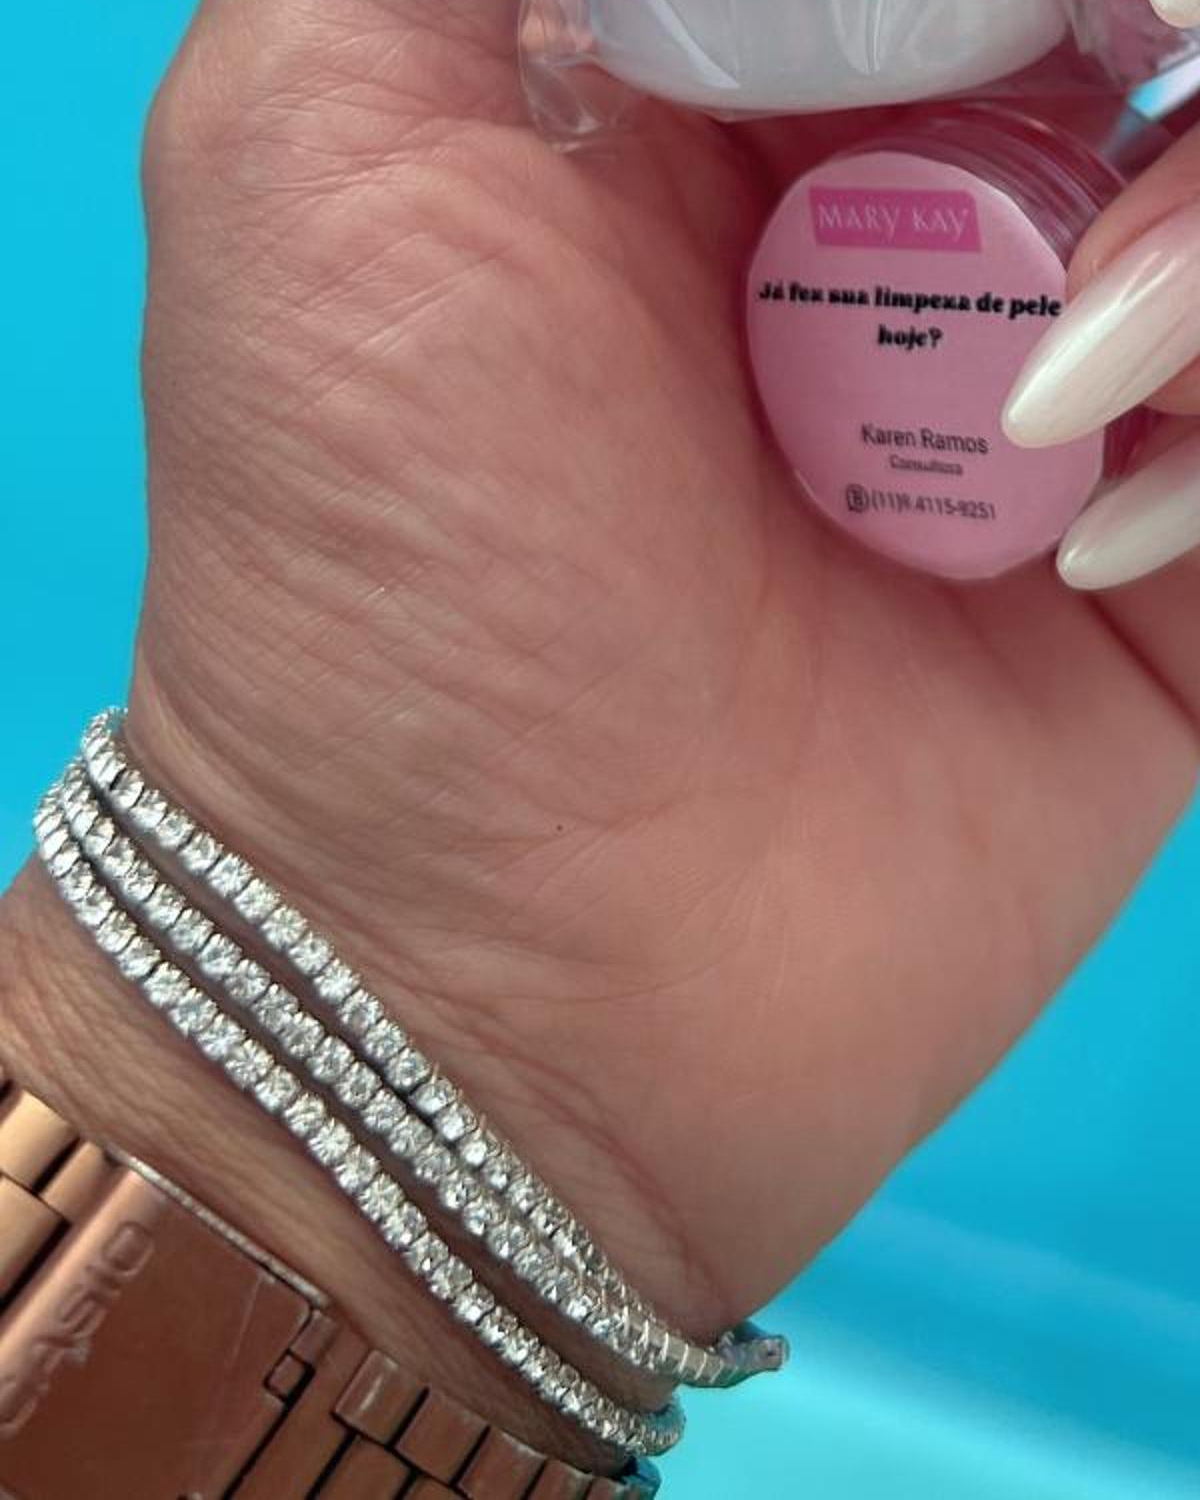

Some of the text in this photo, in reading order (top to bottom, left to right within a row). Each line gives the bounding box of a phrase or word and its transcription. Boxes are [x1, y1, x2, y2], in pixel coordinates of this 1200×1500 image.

[818, 202, 970, 244] MARY KAY
[829, 288, 870, 305] sua
[976, 292, 1004, 313] de
[1009, 294, 1062, 320] pele
[879, 323, 943, 351] hoje?
[861, 423, 989, 454] Karen Ramos
